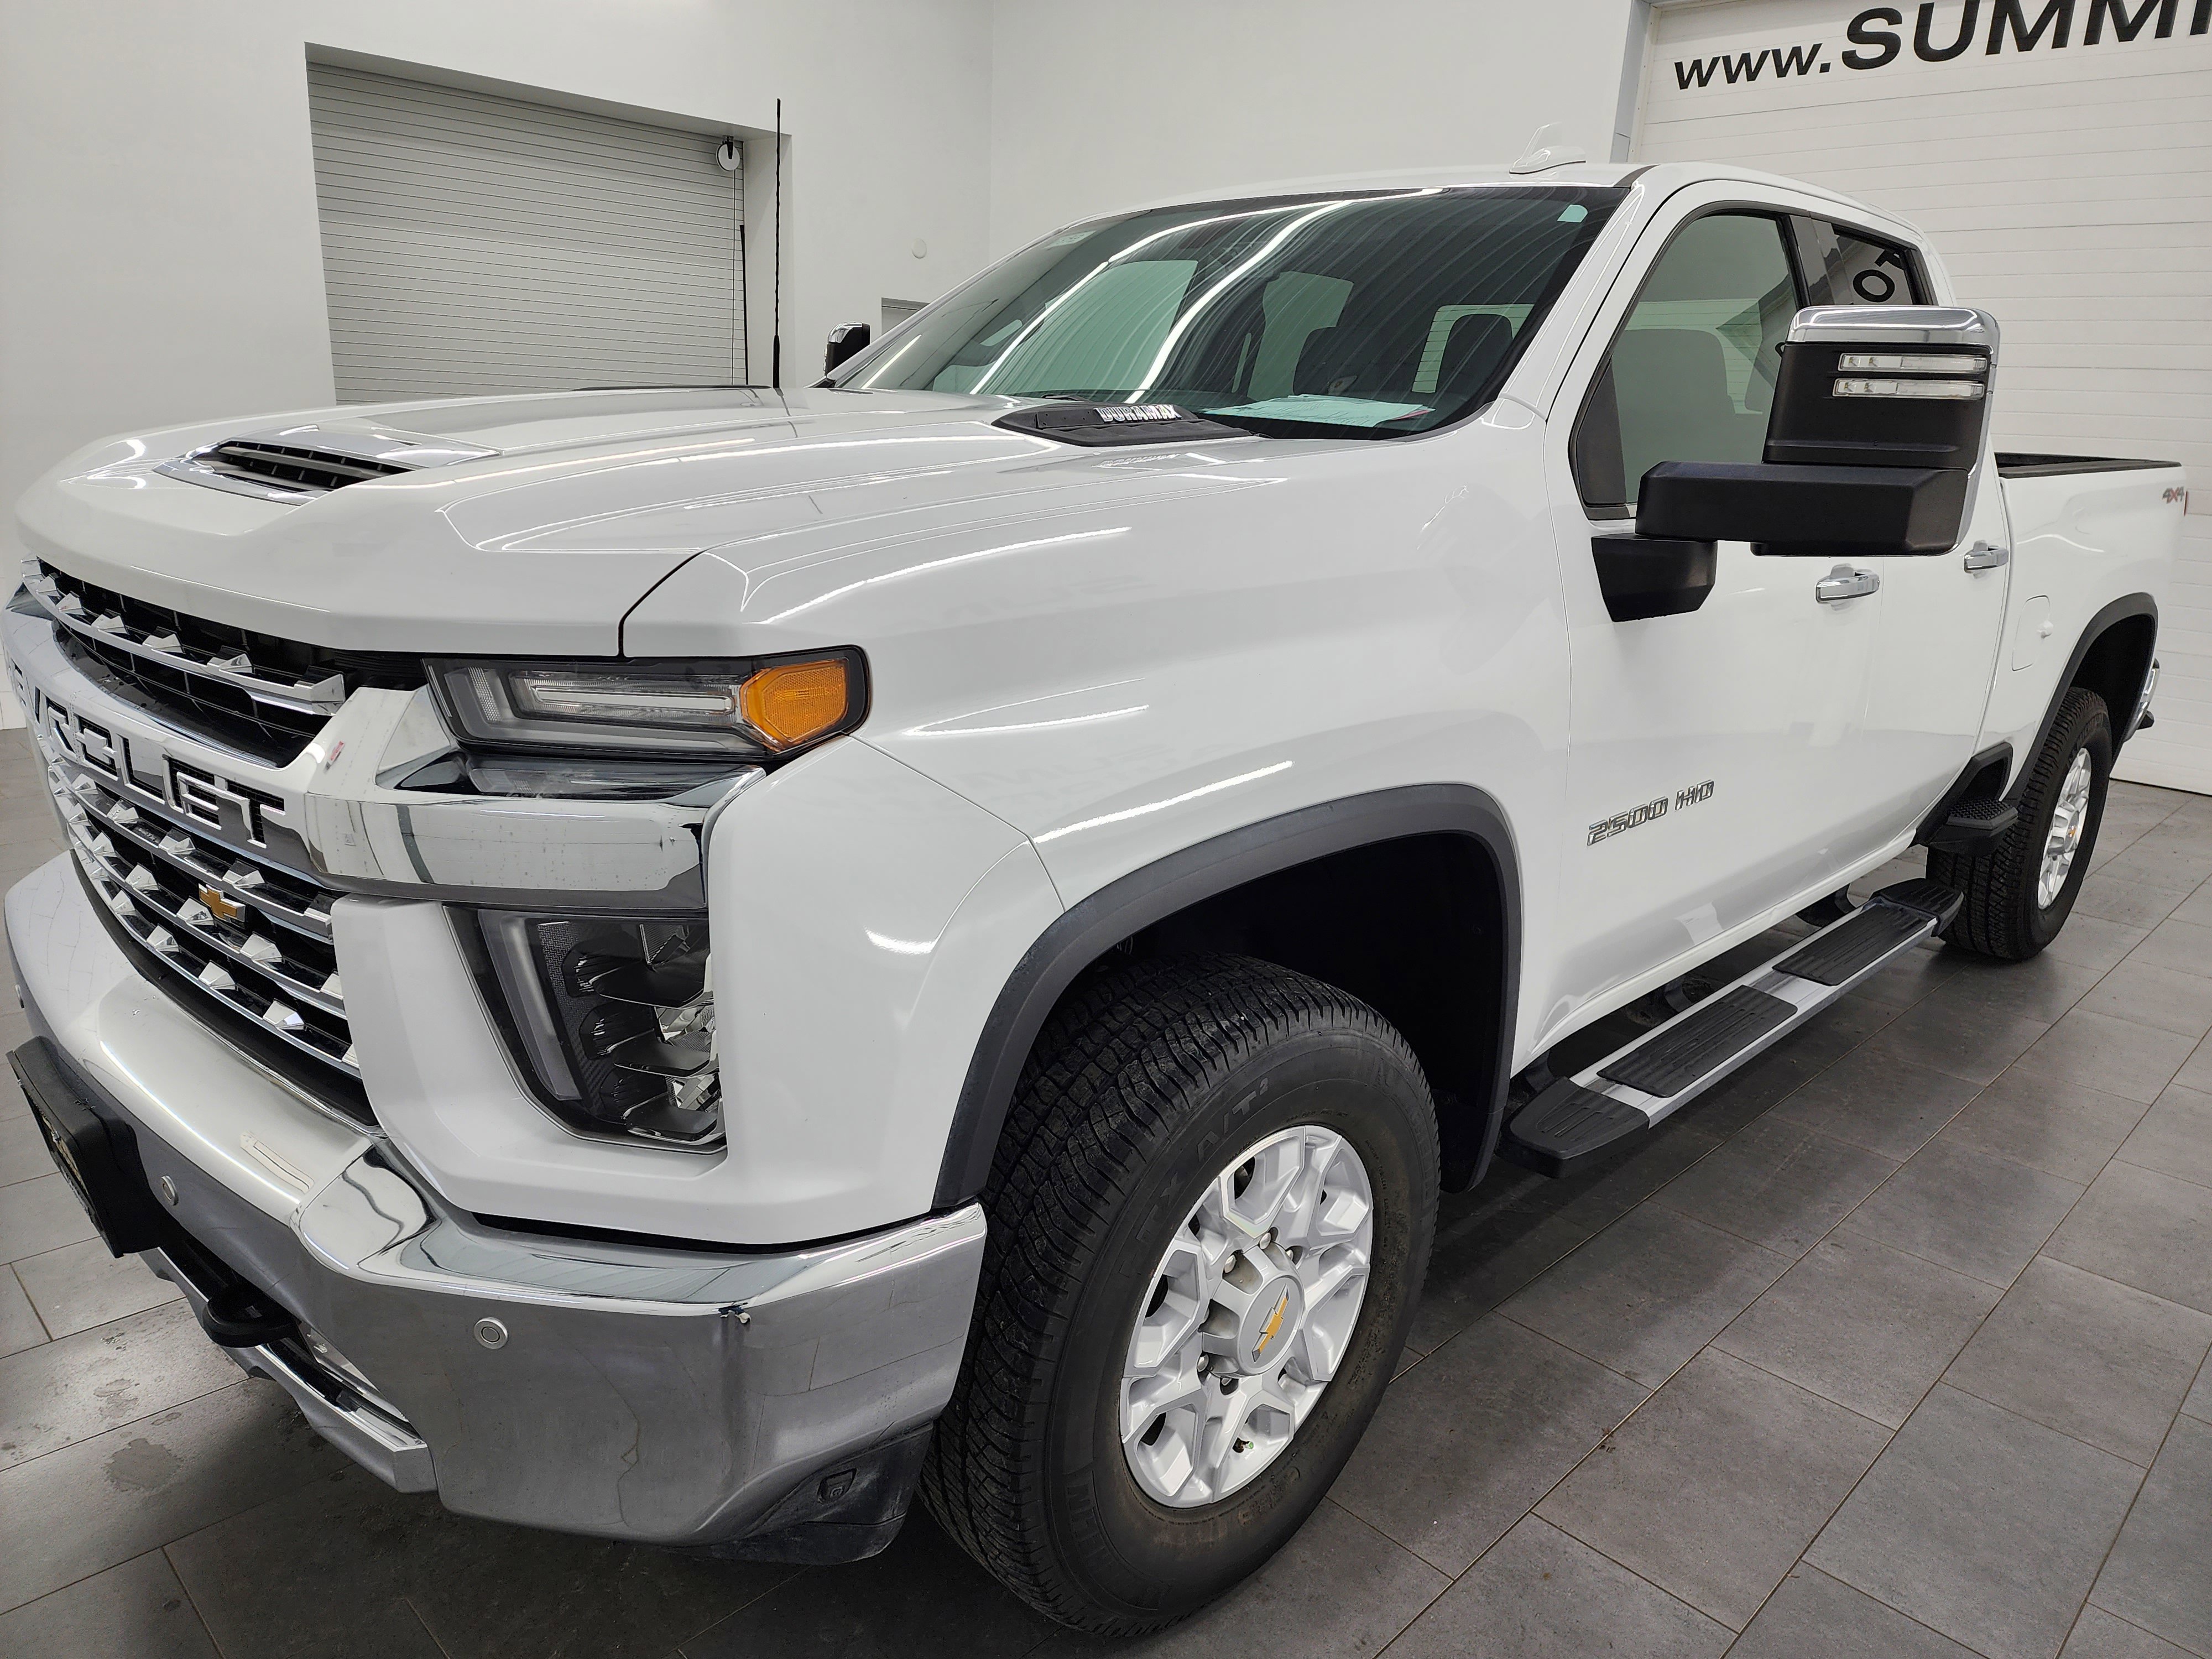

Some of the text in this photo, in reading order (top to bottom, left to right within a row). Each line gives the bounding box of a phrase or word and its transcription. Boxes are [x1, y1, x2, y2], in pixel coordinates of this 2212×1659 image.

[1093, 404, 1182, 424] DURAMAX
[1587, 779, 1714, 847] 2500 HD
